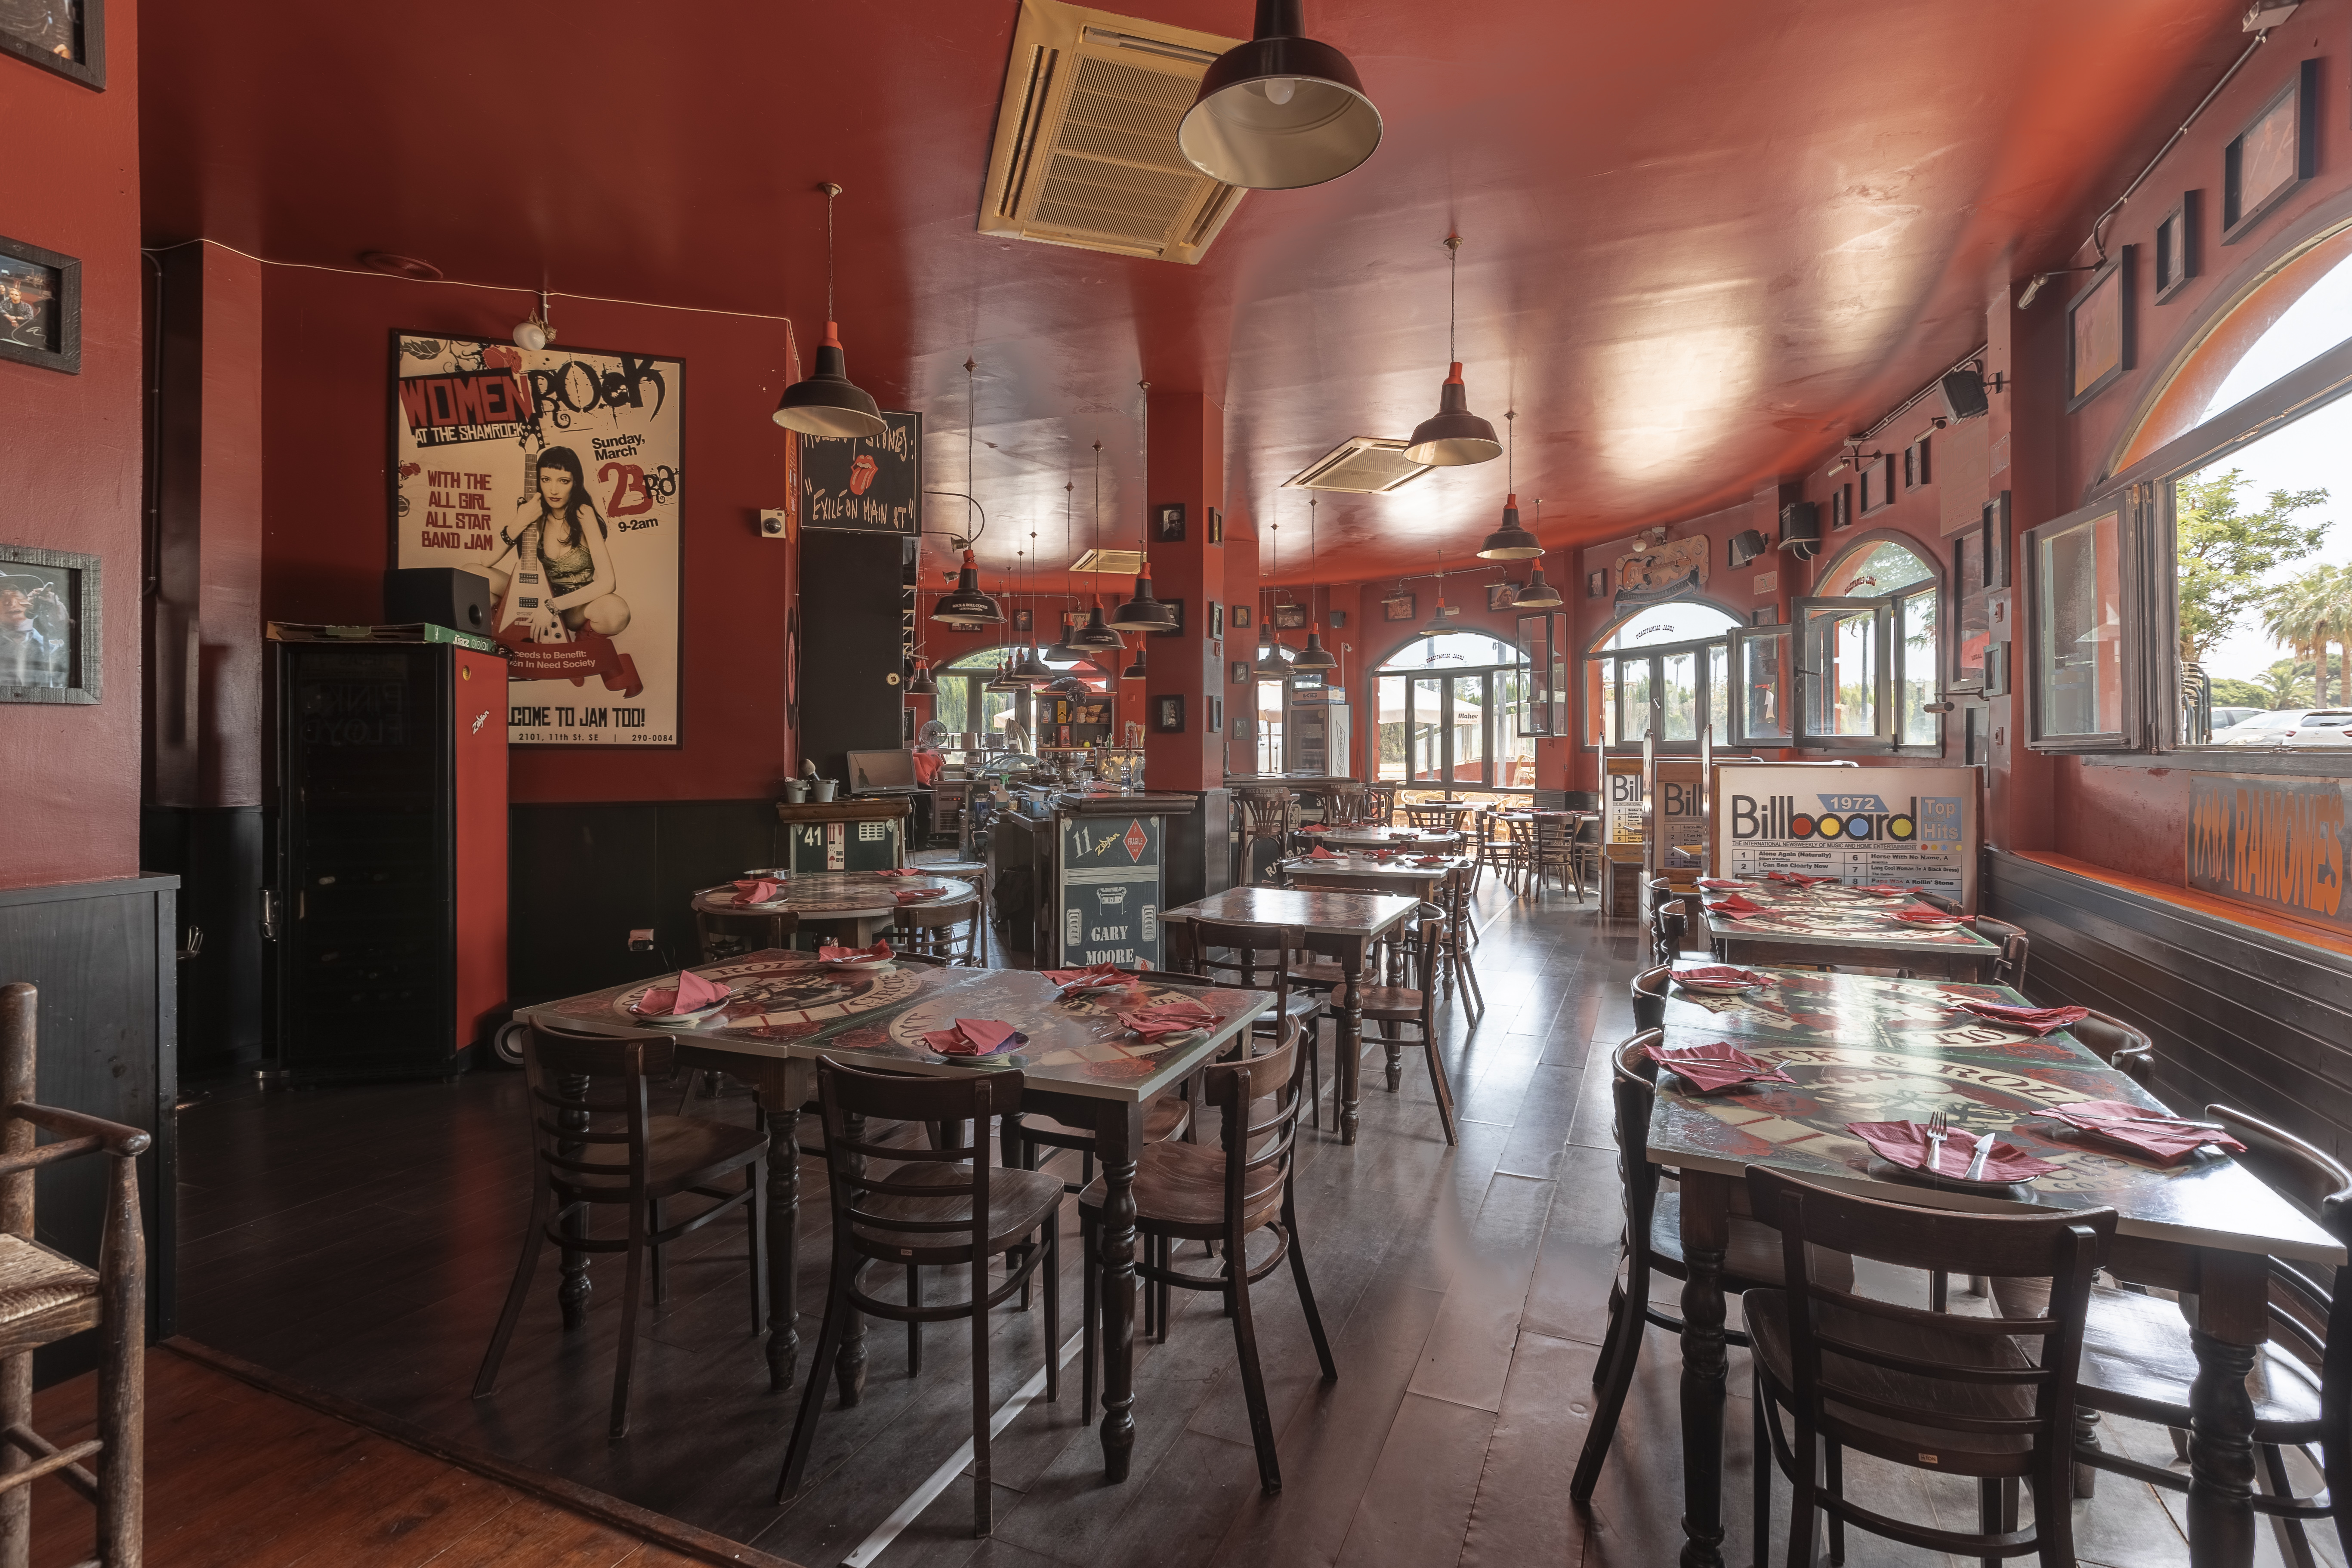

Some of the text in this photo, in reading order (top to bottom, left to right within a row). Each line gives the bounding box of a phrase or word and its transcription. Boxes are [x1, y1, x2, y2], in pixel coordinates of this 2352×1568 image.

[399, 374, 536, 427] WOMEN
[415, 422, 524, 444] AT THE SHAMROCK
[591, 432, 645, 450] Sunday,
[595, 445, 637, 461] March
[427, 469, 492, 491] WITH THE
[428, 491, 491, 510] ALL GIRL
[846, 498, 857, 519] ON
[863, 496, 887, 524] MAIN
[426, 511, 491, 531] ALL STAR
[617, 516, 659, 533] 9-2am
[422, 532, 493, 551] BAND JAM
[1674, 582, 1687, 590] STRY
[537, 660, 560, 668] Need
[562, 658, 596, 669] Society
[554, 650, 586, 659] Benefit:
[508, 707, 645, 727] COME TO JAM TOO!
[519, 733, 543, 742] 2101,
[1830, 797, 1875, 810] 1972
[1924, 799, 1956, 818] Top
[1732, 795, 1917, 841] Billboard
[804, 826, 821, 846] 41
[1923, 823, 1958, 839] Hits
[1073, 826, 1093, 858] 11
[1095, 833, 1120, 856] Zildjian
[2234, 789, 2345, 917] RAMONES
[1091, 926, 1128, 941] GARY
[1086, 948, 1134, 965] MOORE
[849, 974, 905, 1006] CIRCUS
[1871, 1056, 1910, 1068] &
